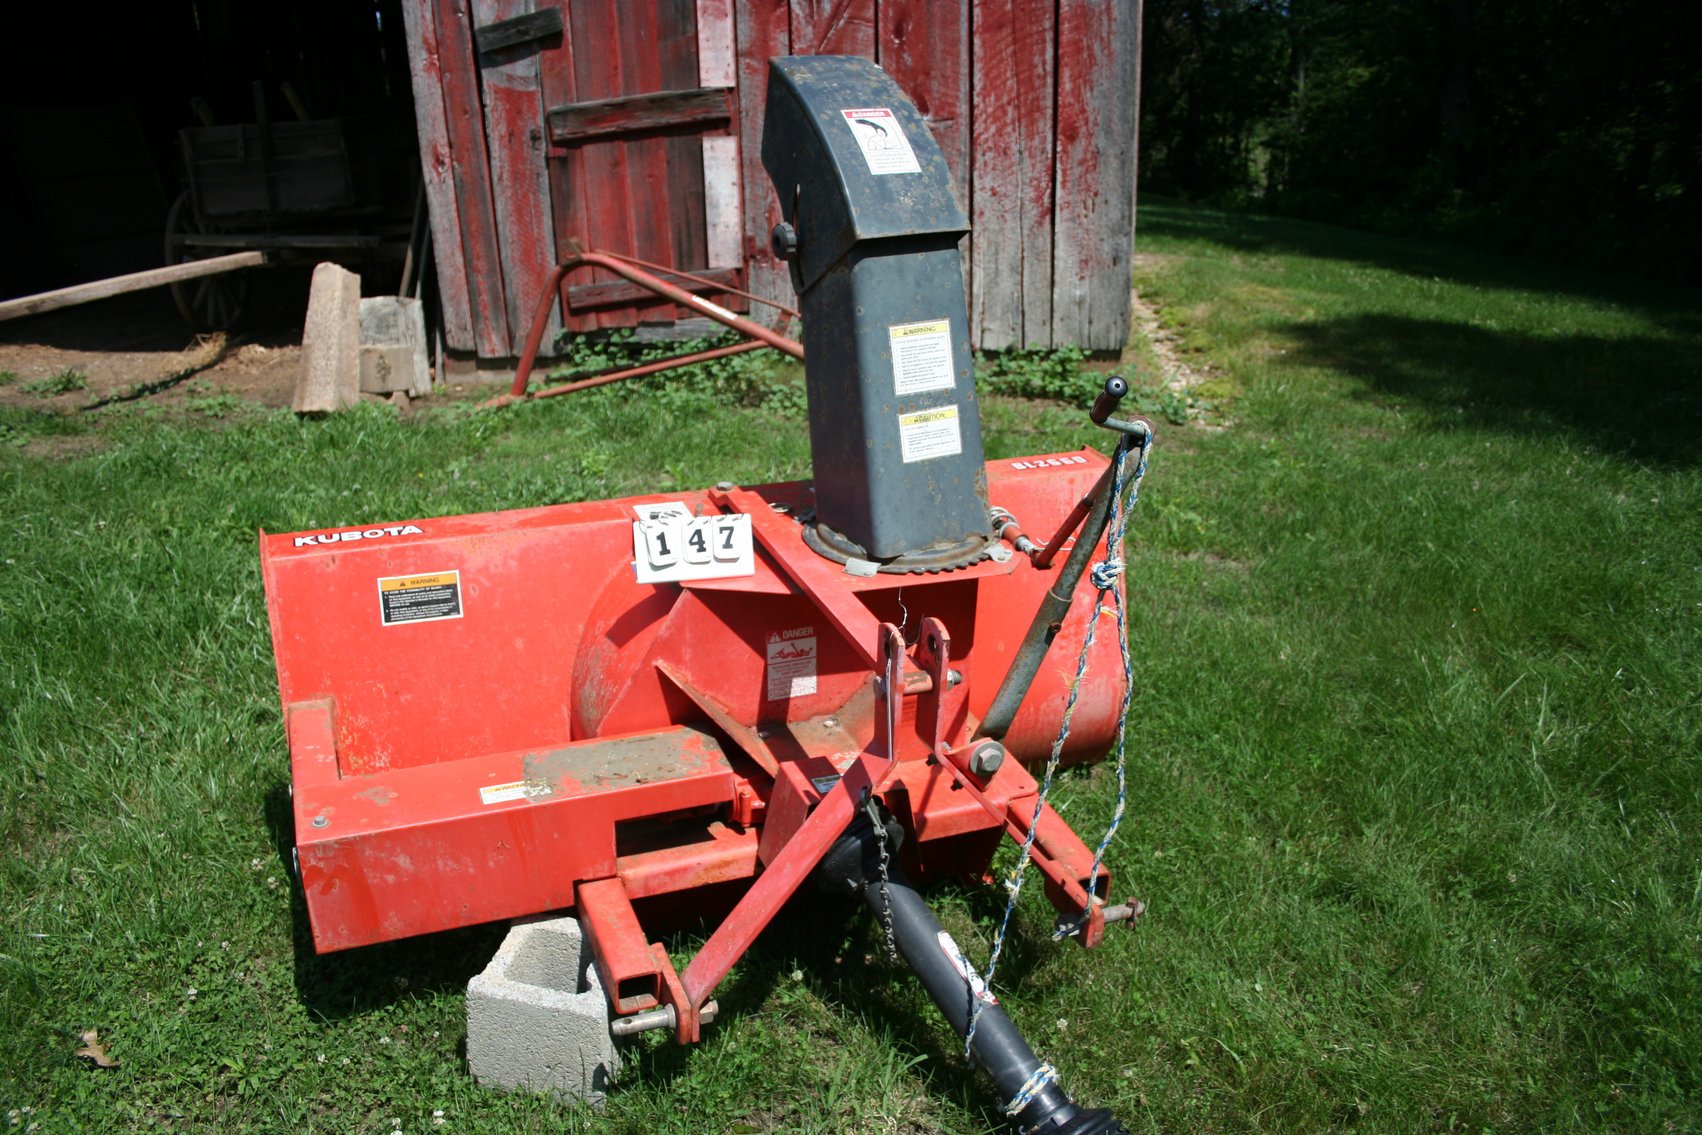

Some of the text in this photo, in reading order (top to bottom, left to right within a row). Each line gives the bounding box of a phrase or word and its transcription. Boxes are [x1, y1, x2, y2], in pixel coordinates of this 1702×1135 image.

[908, 326, 936, 334] WARNING
[294, 525, 423, 547] KUBOTA
[410, 577, 440, 585] WARNING
[783, 627, 814, 639] DANGER
